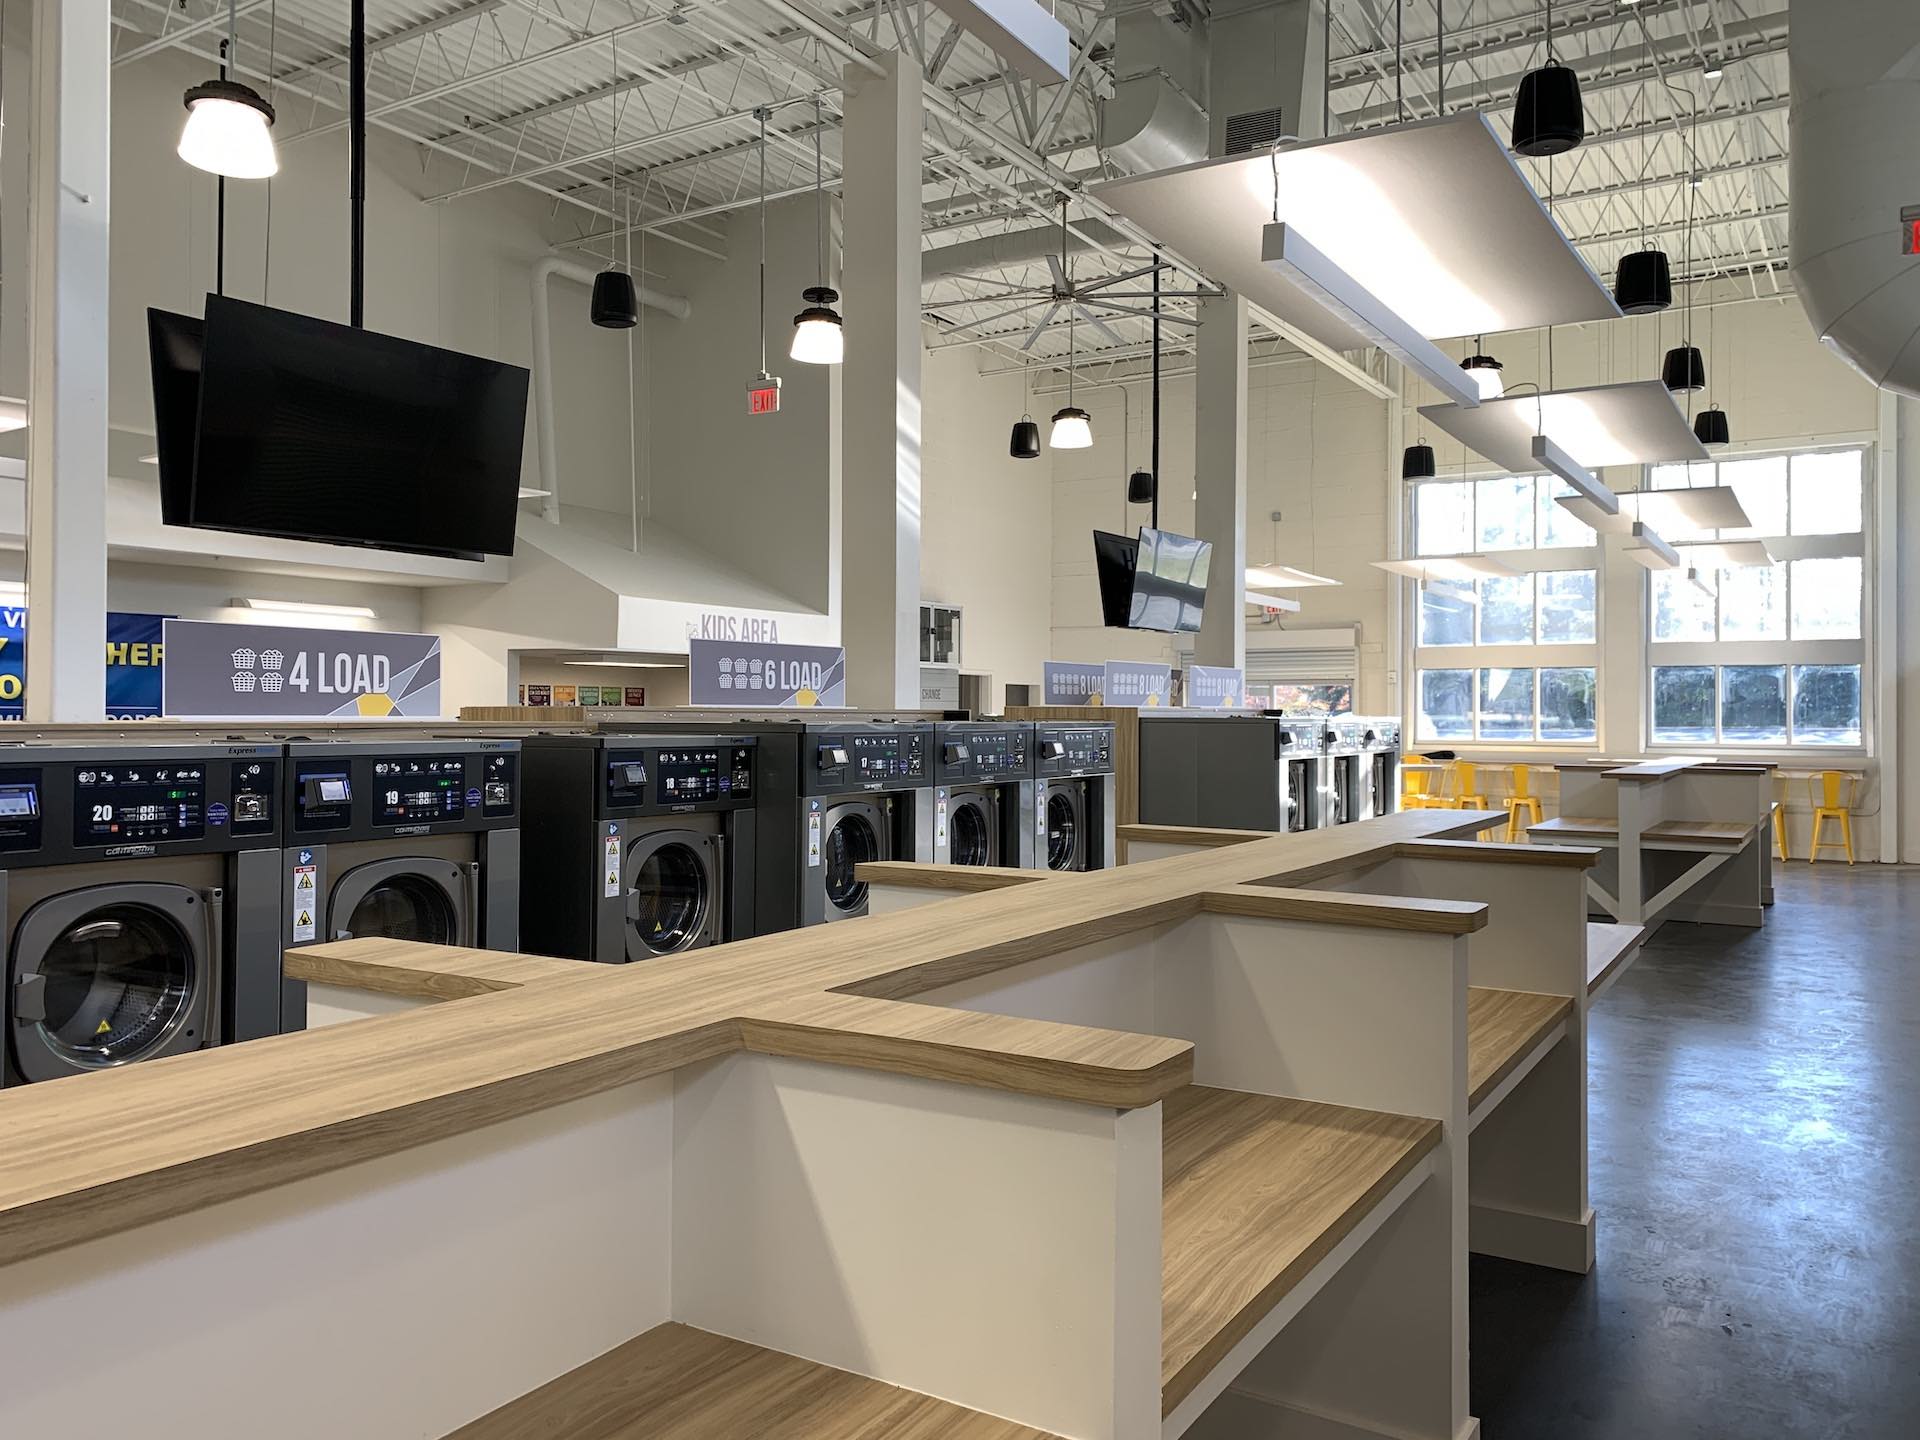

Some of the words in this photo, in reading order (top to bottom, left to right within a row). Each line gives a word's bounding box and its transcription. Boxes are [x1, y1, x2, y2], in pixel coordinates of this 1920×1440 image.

[754, 390, 776, 412] EXIT
[702, 614, 736, 641] KIDS
[741, 618, 778, 643] AREA
[289, 652, 309, 693] 4
[318, 653, 390, 694] LOAD
[765, 660, 776, 689] 6
[781, 661, 822, 690] LOAD
[1080, 675, 1086, 695] 8
[1139, 675, 1144, 694] 8
[1145, 675, 1165, 695] LOAD
[666, 778, 675, 789] 18
[386, 790, 399, 805] 19
[93, 805, 112, 821] 20
